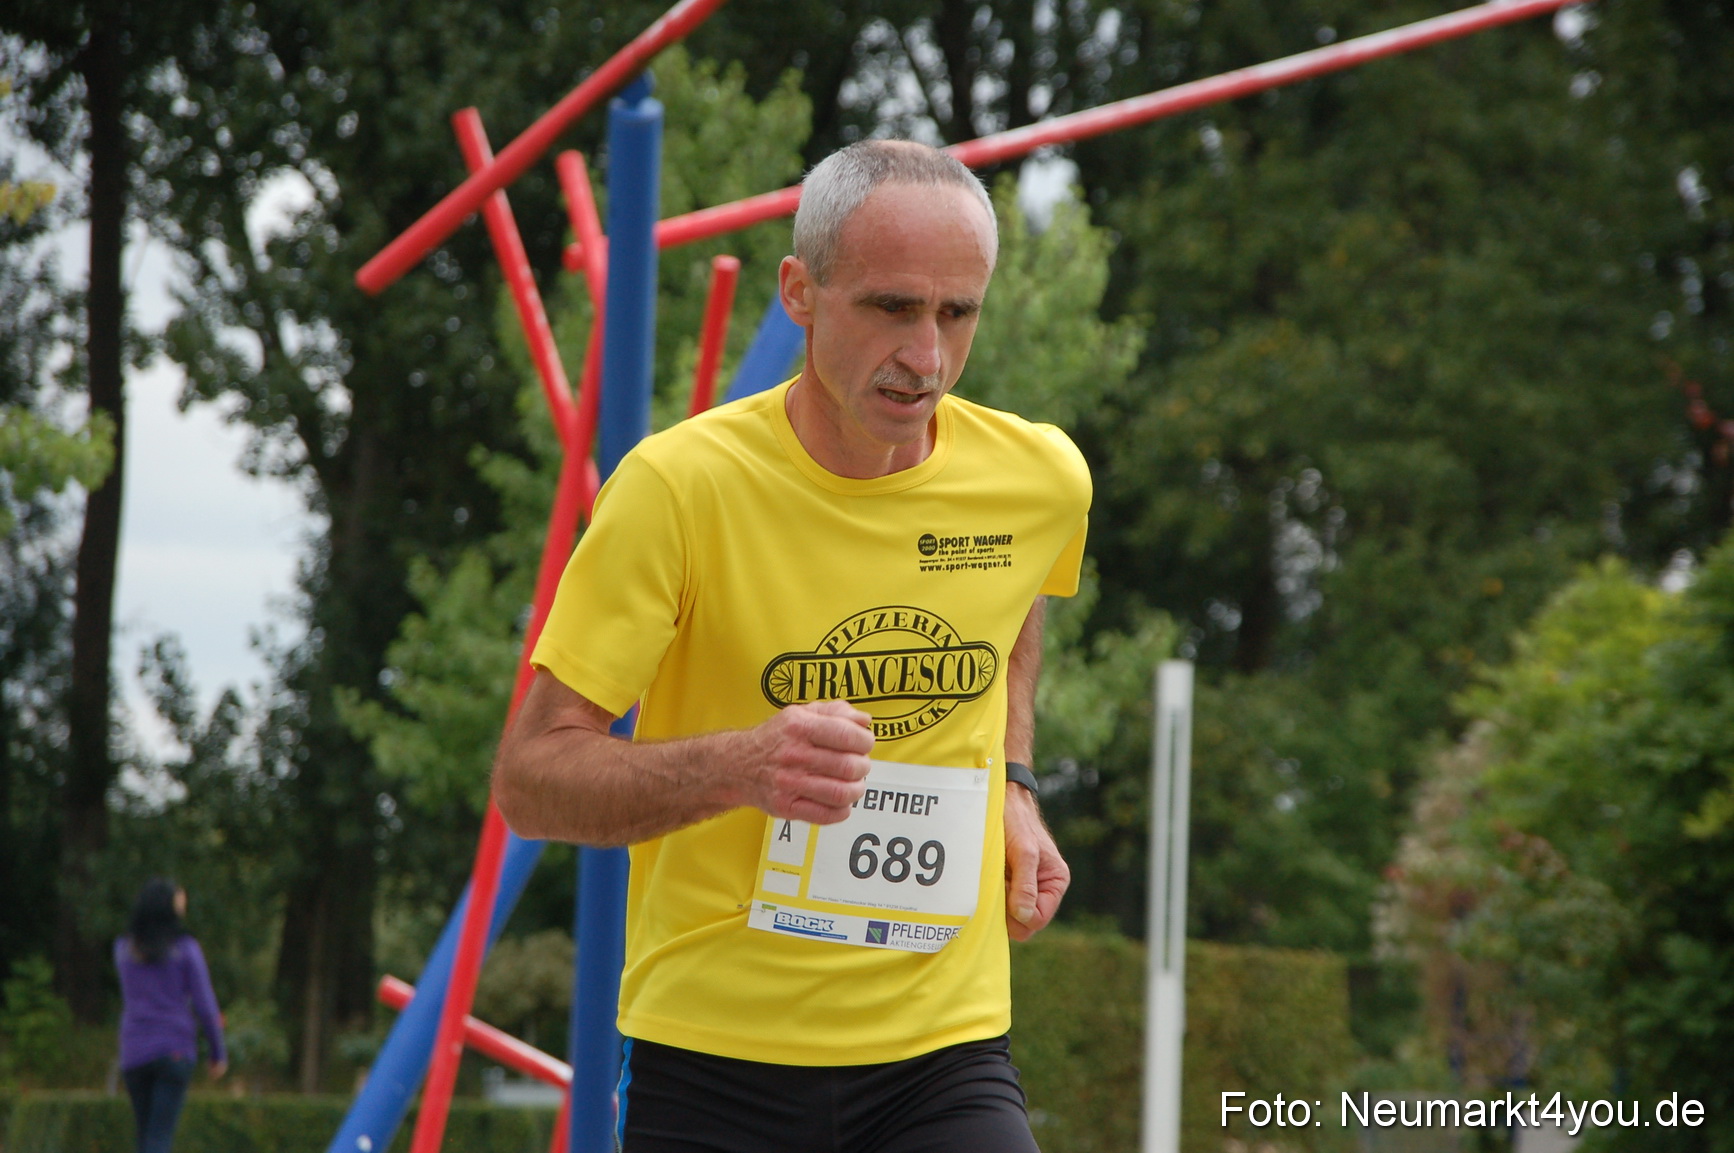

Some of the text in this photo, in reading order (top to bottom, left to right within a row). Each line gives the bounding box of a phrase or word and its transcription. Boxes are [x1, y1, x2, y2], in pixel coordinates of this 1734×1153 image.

[939, 534, 1013, 548] SPORT WAGNER
[951, 546, 967, 556] point
[969, 546, 976, 554] of
[976, 547, 995, 555] sports
[920, 558, 1011, 572] www.sport-wagner.de
[825, 611, 952, 655] PIZZERIA
[797, 652, 976, 700] FRANCESCO
[852, 788, 939, 816] erner
[778, 819, 791, 843] A
[848, 832, 946, 887] 689
[775, 912, 835, 931] BOCK
